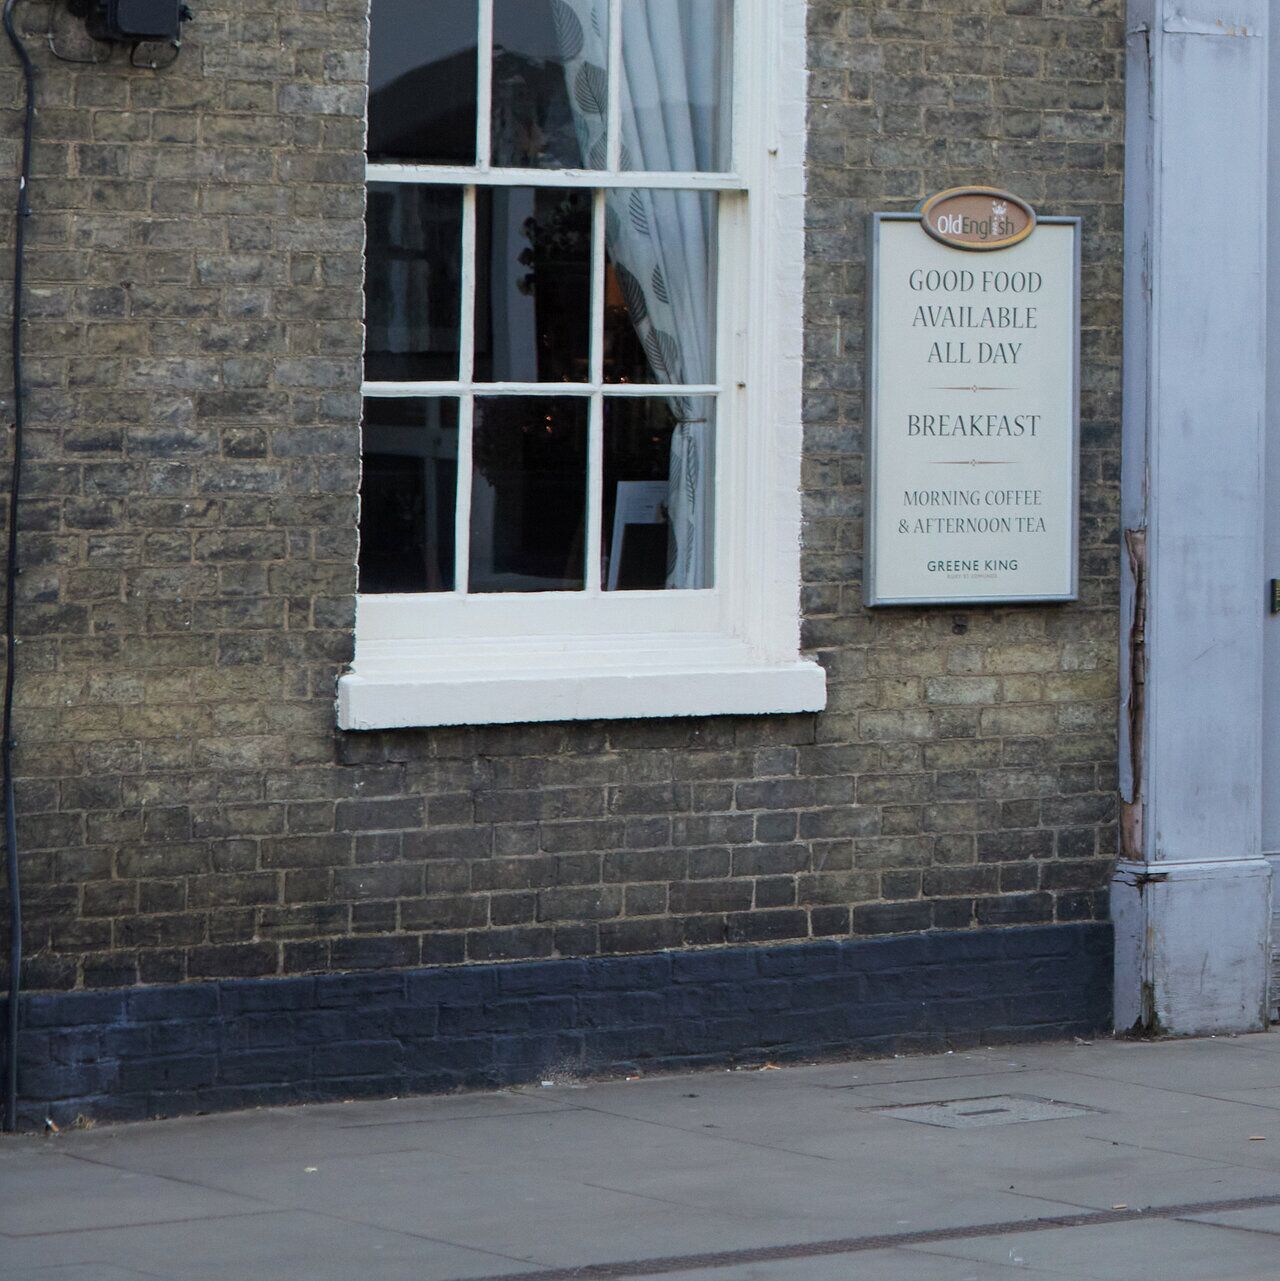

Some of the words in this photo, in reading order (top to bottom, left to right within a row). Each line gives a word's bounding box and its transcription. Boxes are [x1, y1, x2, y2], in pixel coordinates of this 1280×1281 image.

[909, 269, 974, 293] GOOD
[982, 271, 1042, 293] FOOD
[912, 305, 1038, 329] AVAILABLE
[927, 341, 971, 364] ALL
[977, 342, 1023, 364] DAY
[907, 414, 1041, 437] BREAKFAST
[903, 490, 981, 506] MORNING
[984, 490, 1043, 506] COFFEE
[898, 518, 910, 534] &
[913, 517, 1011, 533] AFTERNOON
[1014, 517, 1046, 533] TEA
[927, 560, 979, 572] GREENE
[984, 559, 1018, 571] KING
